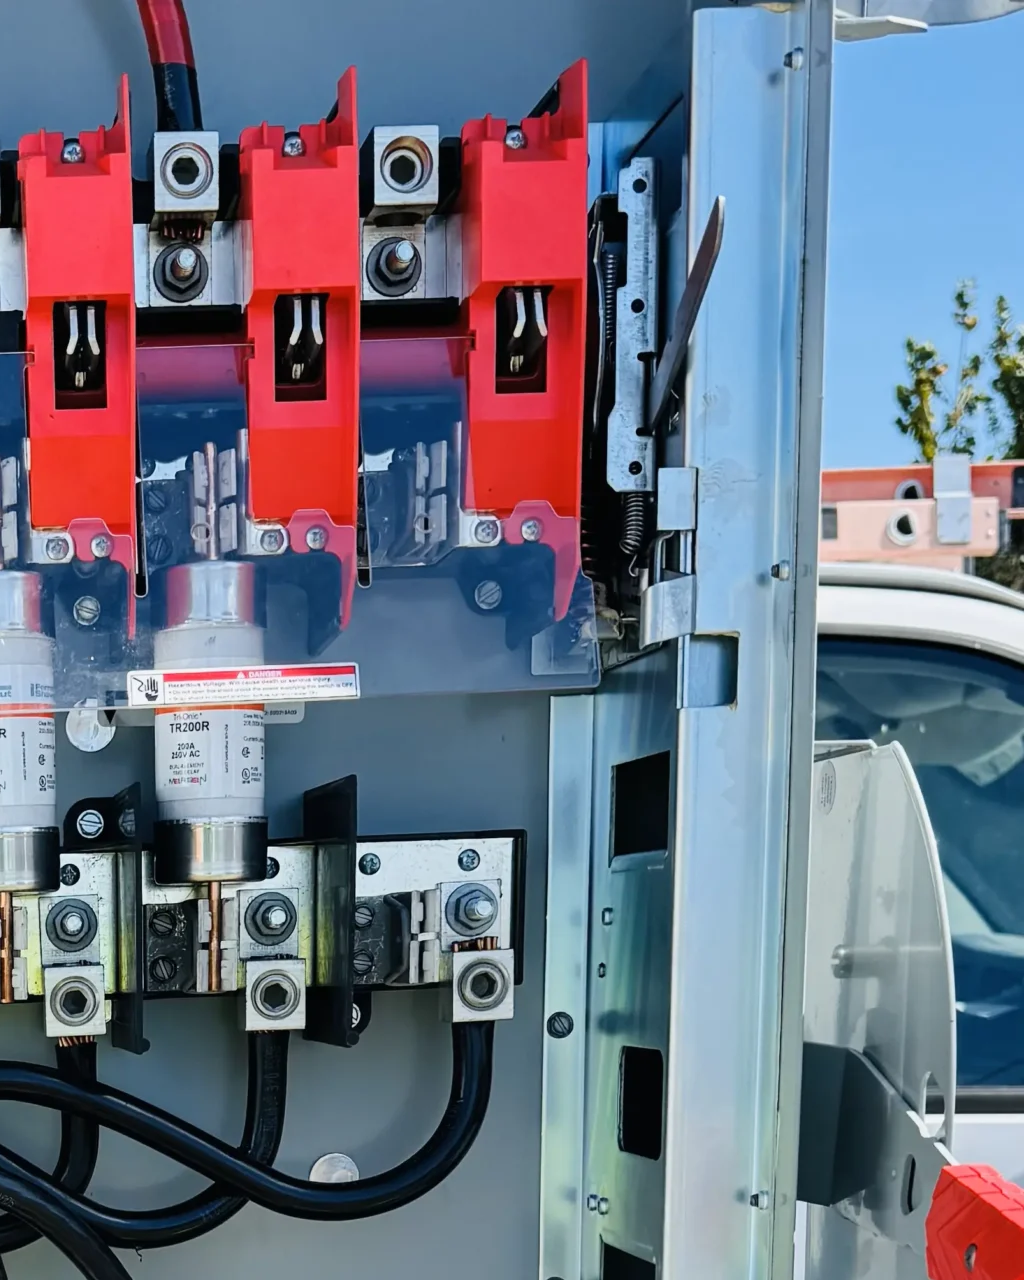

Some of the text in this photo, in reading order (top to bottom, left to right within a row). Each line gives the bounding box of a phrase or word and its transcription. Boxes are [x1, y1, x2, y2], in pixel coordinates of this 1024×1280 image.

[248, 670, 282, 678] DANGER
[169, 721, 210, 734] TR200R
[178, 742, 196, 751] 200A
[189, 750, 200, 758] AC
